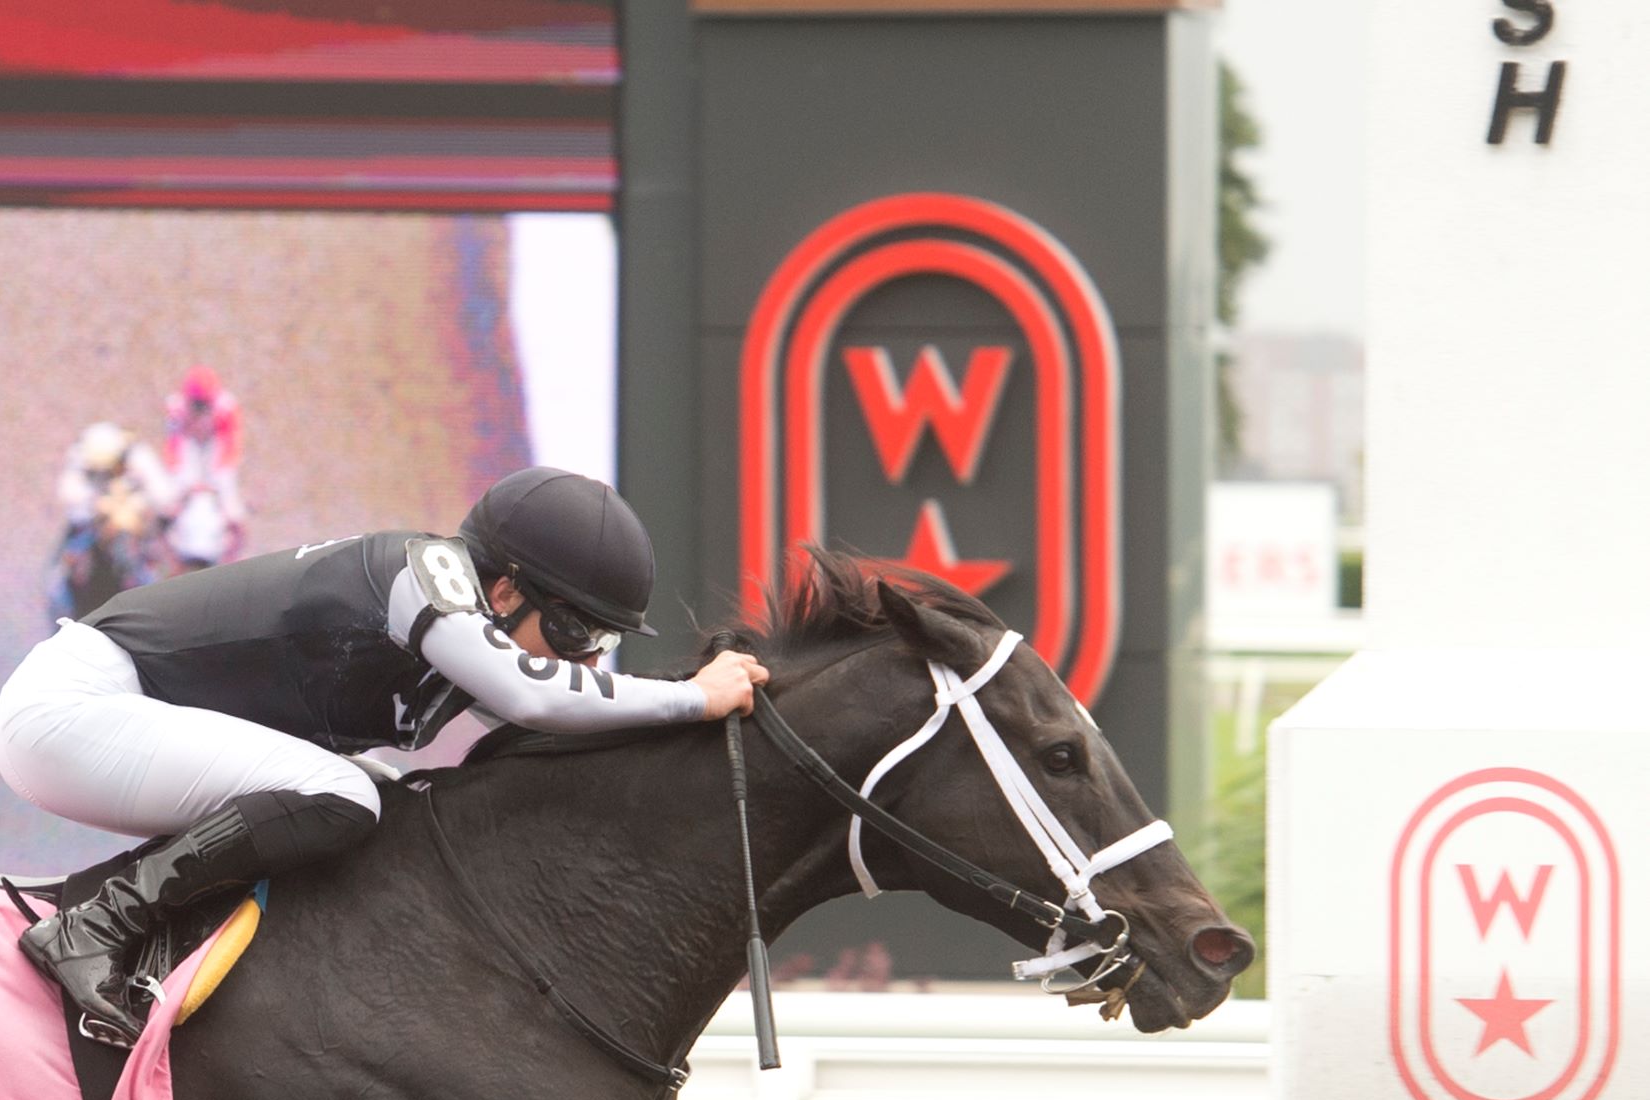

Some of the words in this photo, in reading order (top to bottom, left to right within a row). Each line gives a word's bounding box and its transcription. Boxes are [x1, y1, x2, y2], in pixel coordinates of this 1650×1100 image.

[843, 346, 1012, 482] W
[422, 545, 477, 606] 8
[1455, 864, 1555, 942] W
